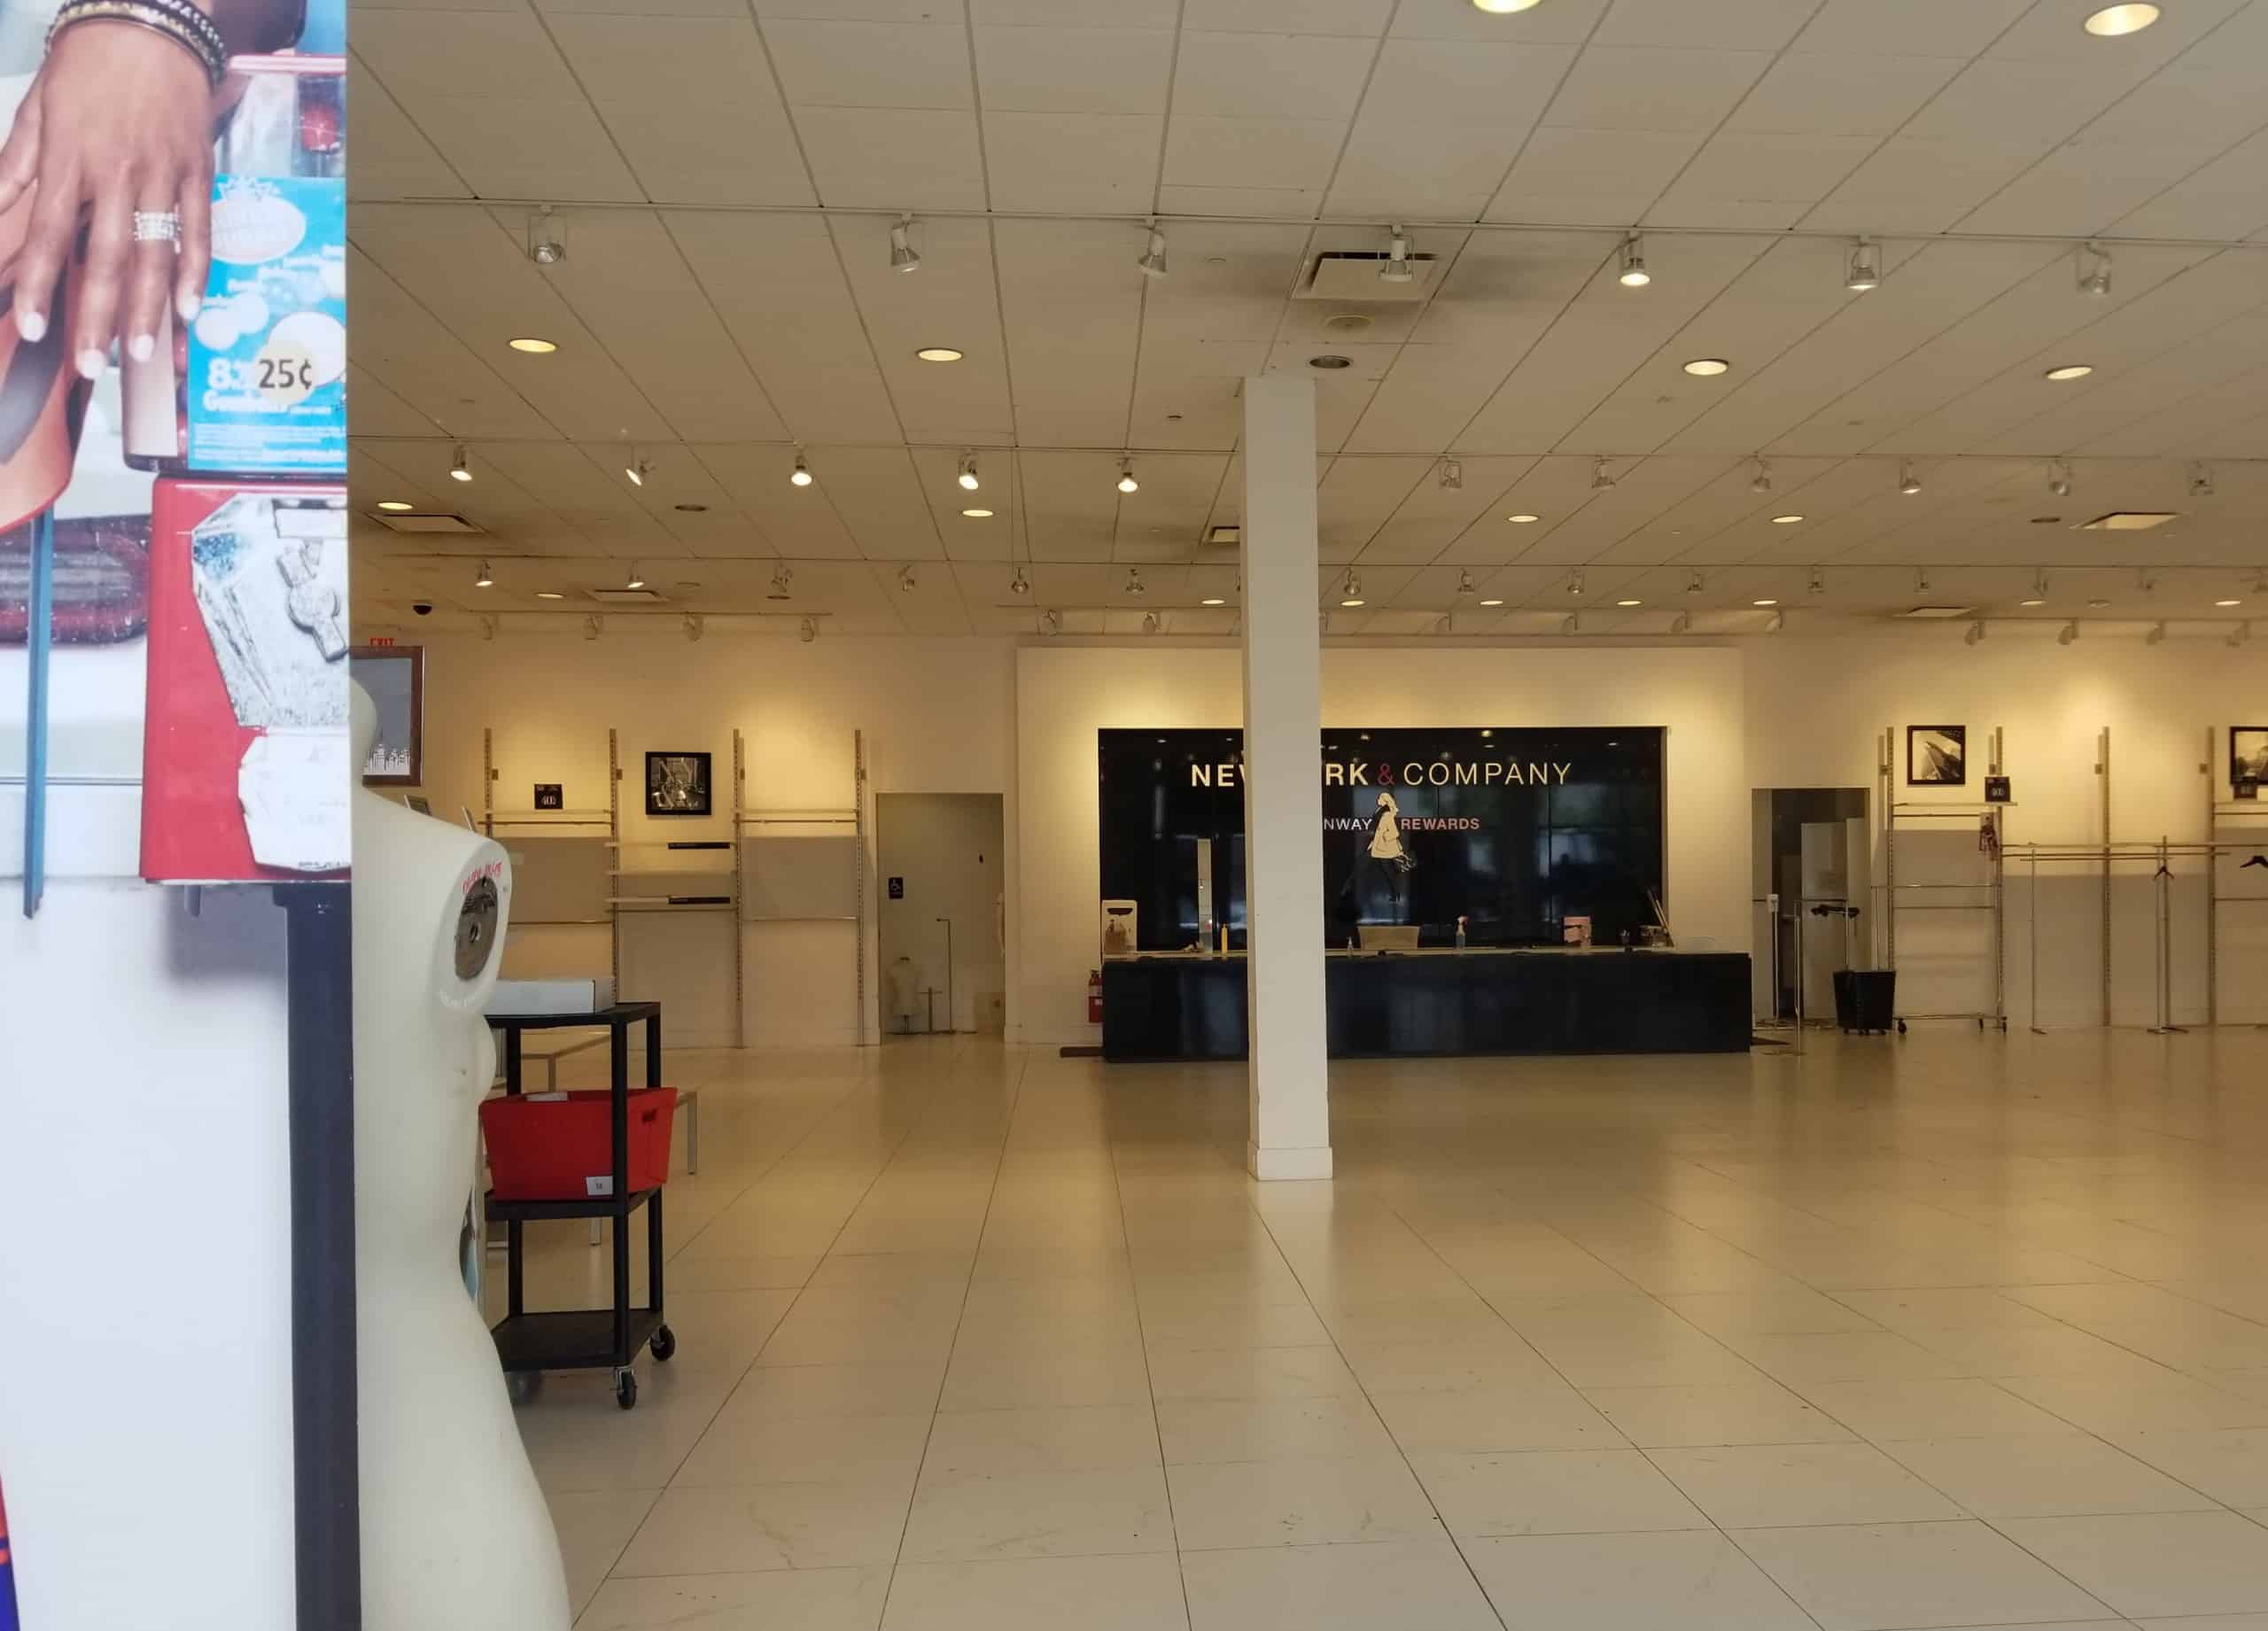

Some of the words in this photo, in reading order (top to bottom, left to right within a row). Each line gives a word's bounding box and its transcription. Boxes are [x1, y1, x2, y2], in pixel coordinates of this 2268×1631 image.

[259, 358, 313, 390] 25¢
[1191, 764, 1247, 787] NE
[1324, 763, 1369, 786] RK
[1378, 763, 1394, 785] &
[1403, 762, 1572, 786] COMPANY
[1323, 818, 1372, 830] NWAY
[1401, 818, 1480, 830] REWARDS
